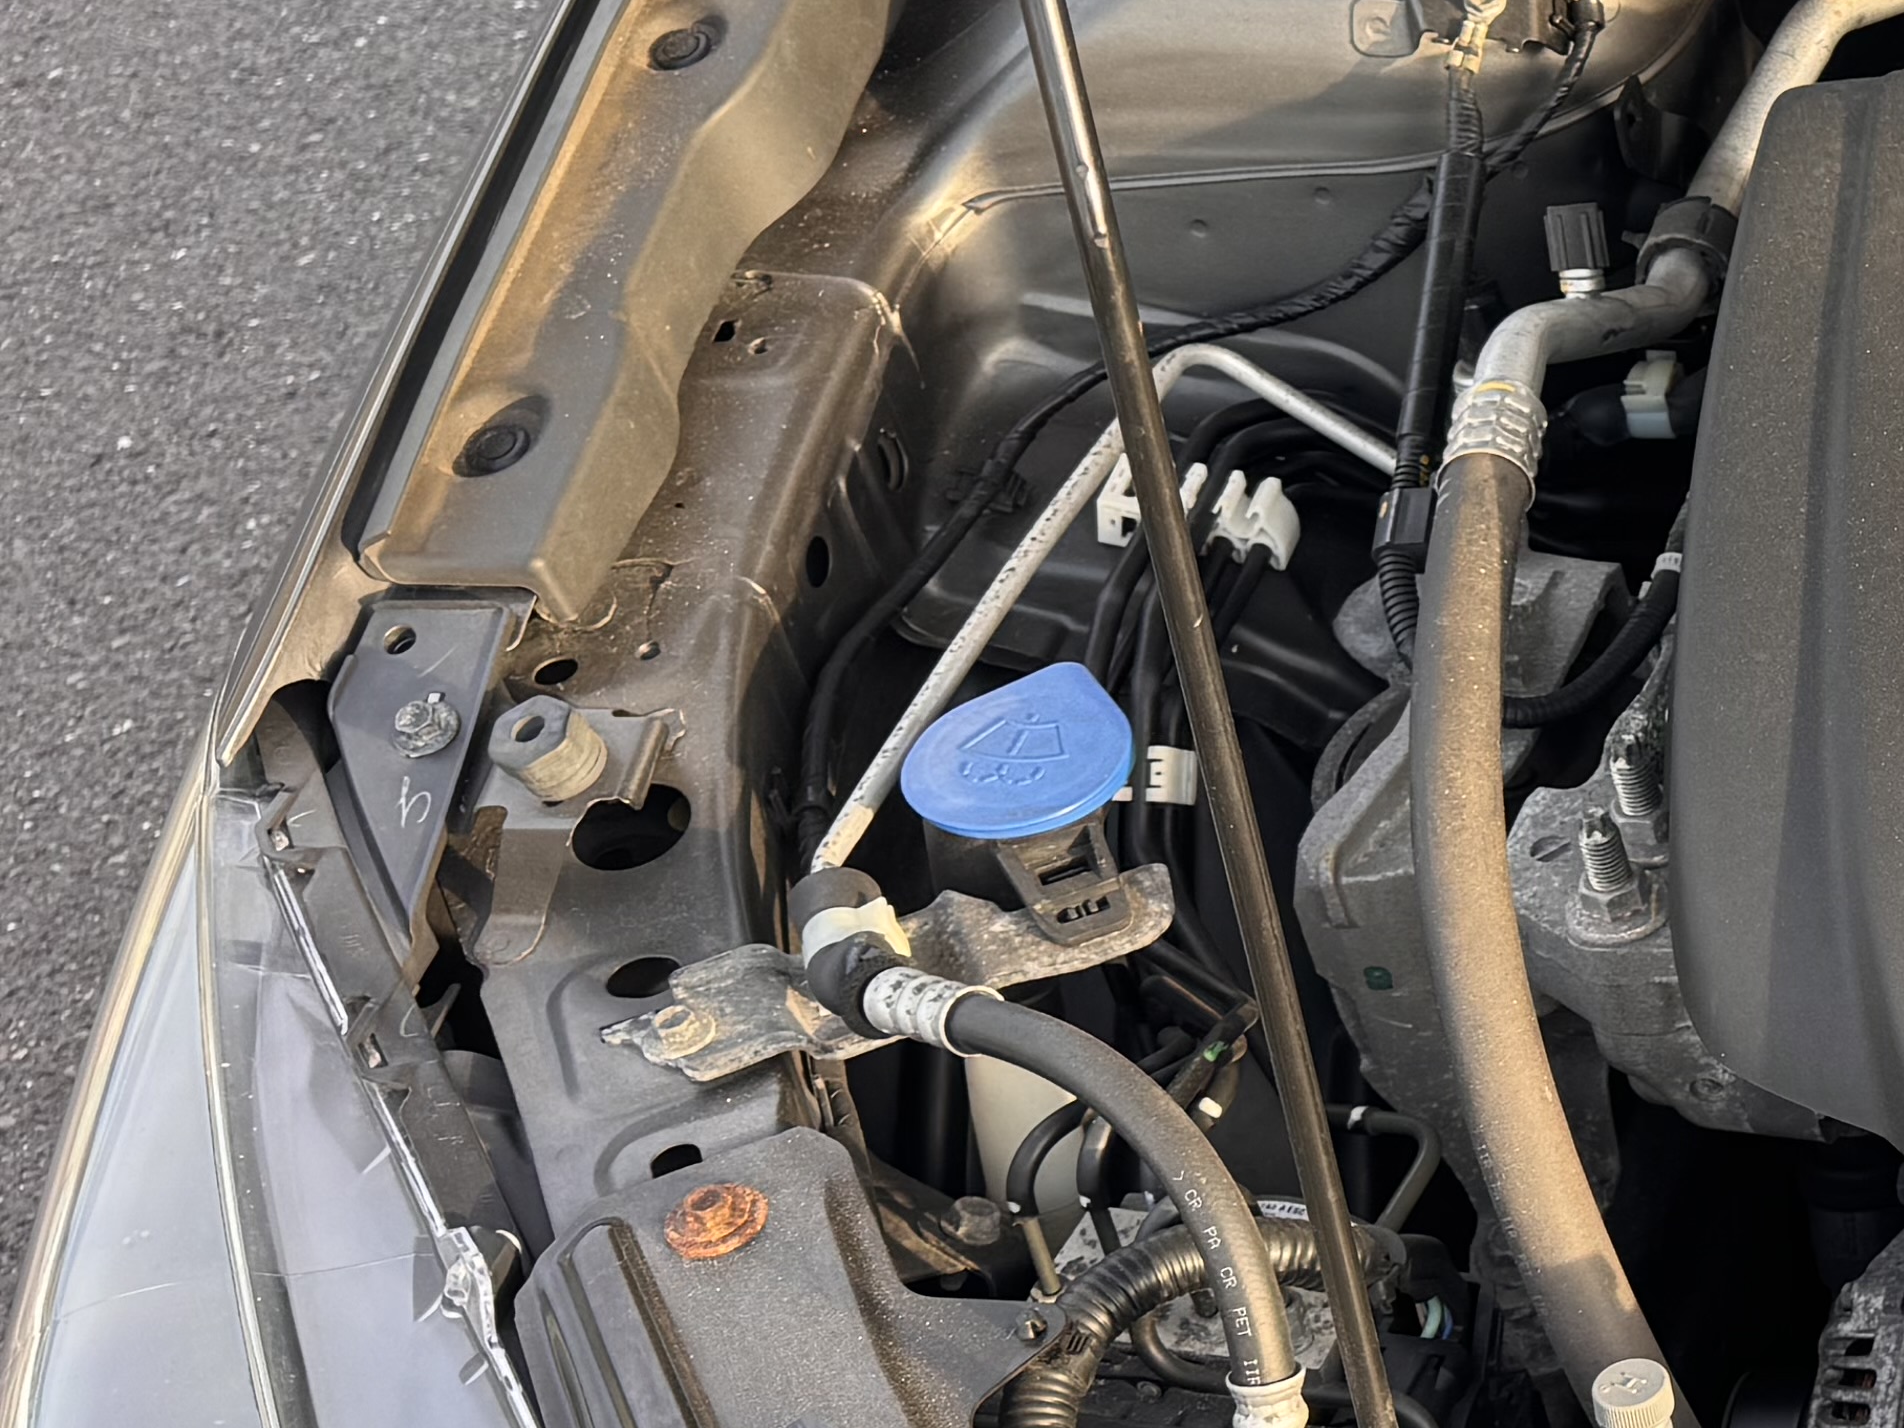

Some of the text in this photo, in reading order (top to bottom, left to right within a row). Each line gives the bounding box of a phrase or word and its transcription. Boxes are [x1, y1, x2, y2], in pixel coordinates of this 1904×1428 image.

[1184, 1188, 1203, 1212] CR
[1203, 1225, 1222, 1250] PA
[1220, 1266, 1238, 1289] CR
[1233, 1306, 1253, 1337] PET
